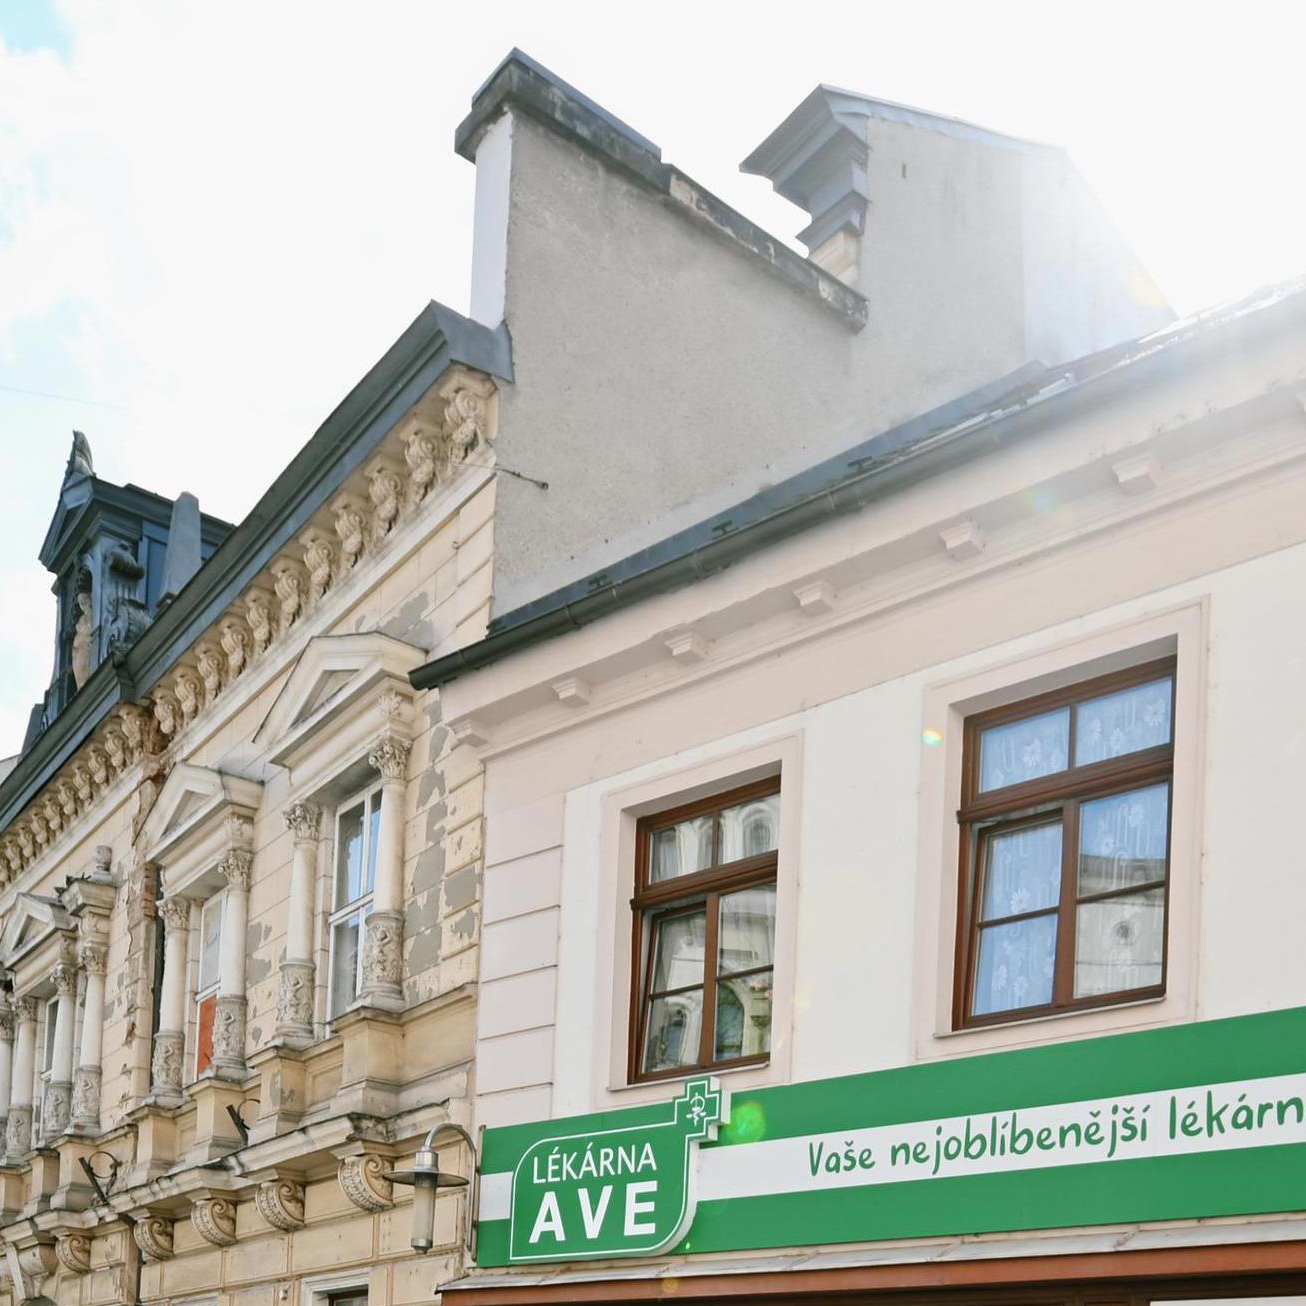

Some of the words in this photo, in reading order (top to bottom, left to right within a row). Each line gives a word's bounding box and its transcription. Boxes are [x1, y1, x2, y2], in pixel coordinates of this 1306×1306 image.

[532, 1141, 658, 1184] LÉKÁRNA
[807, 1139, 877, 1177] Vaše
[889, 1103, 1150, 1176] nejoblíbenější
[528, 1180, 658, 1244] AVE
